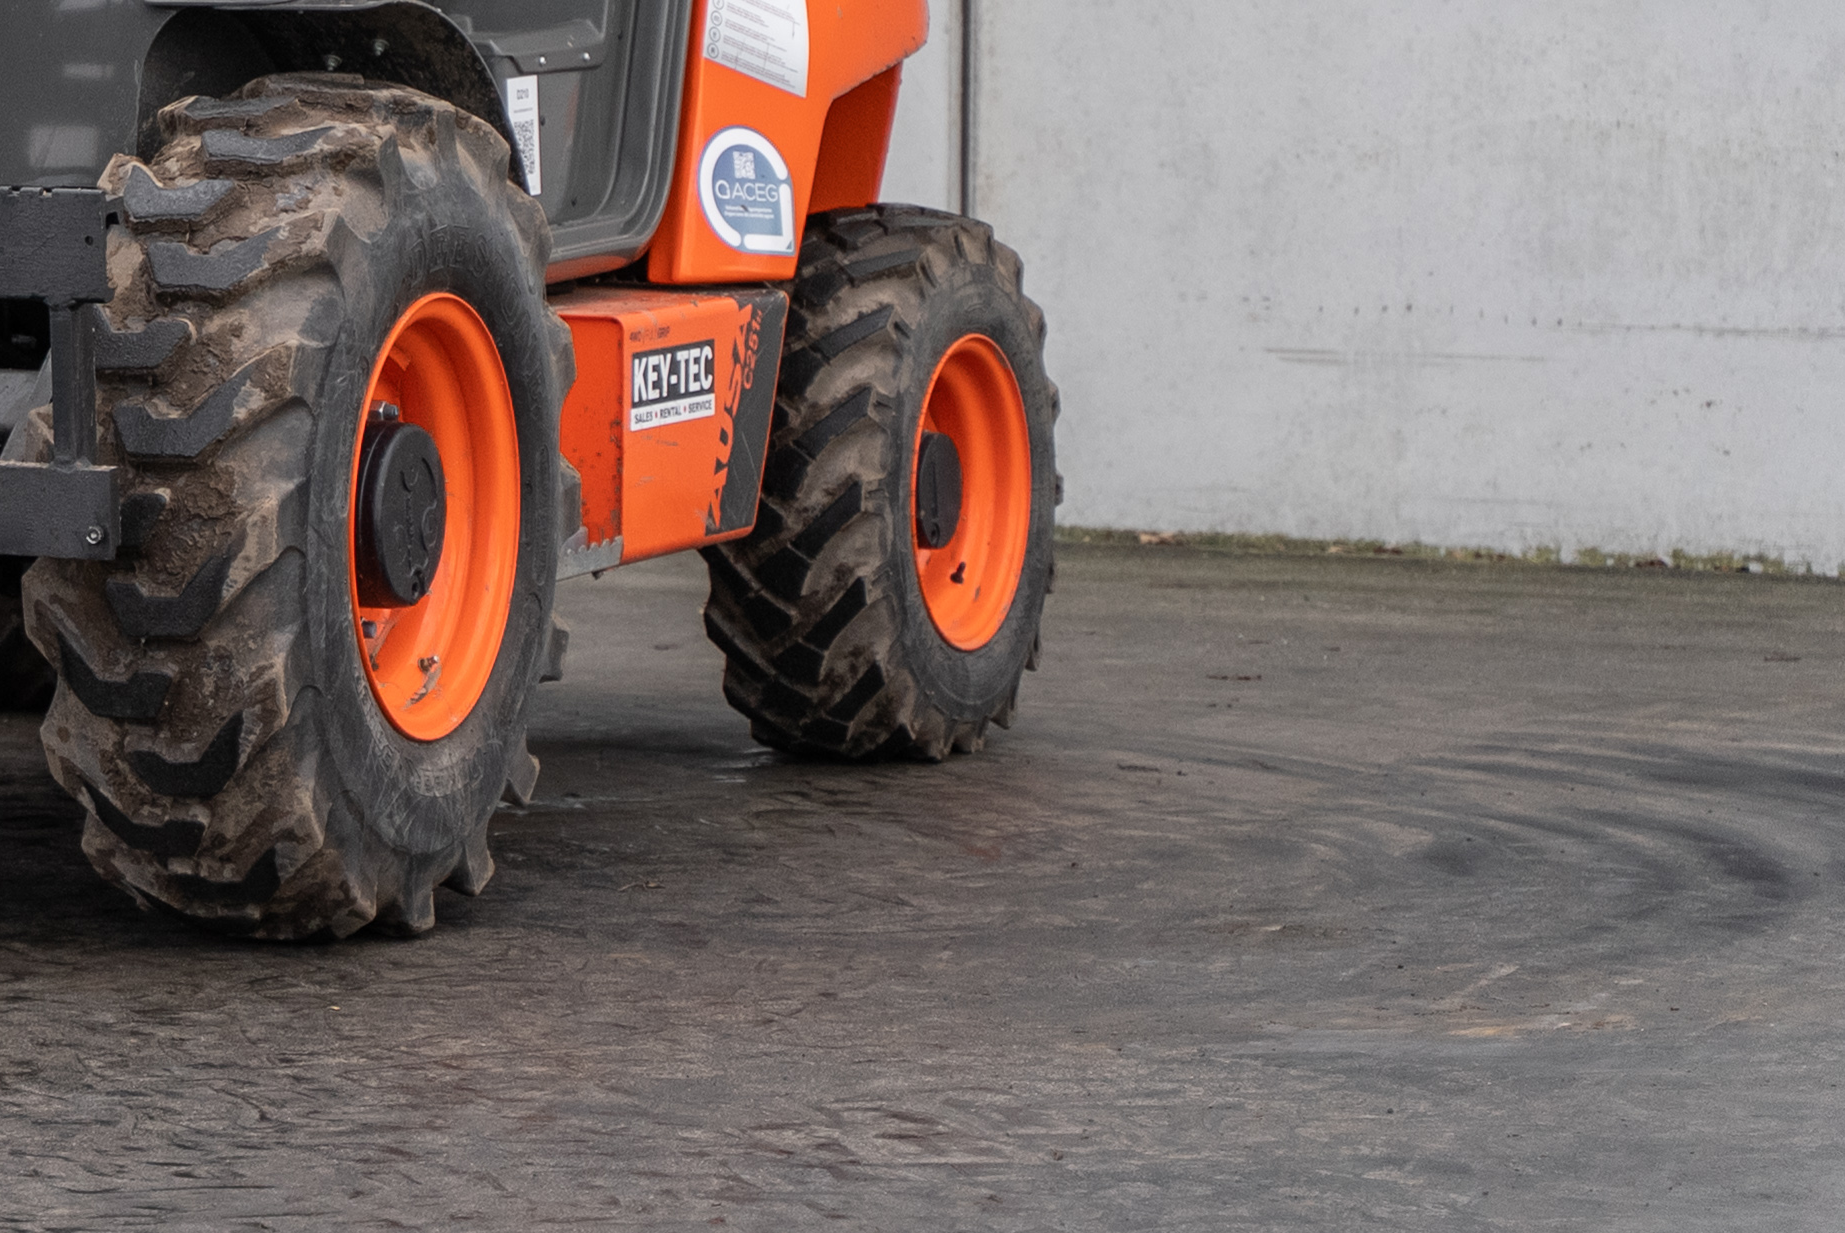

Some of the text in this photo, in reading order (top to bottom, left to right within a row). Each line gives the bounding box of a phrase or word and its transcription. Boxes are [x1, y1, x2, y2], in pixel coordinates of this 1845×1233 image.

[633, 345, 713, 403] KEY-TEC
[634, 399, 712, 424] SALES RENTAL SERVICE
